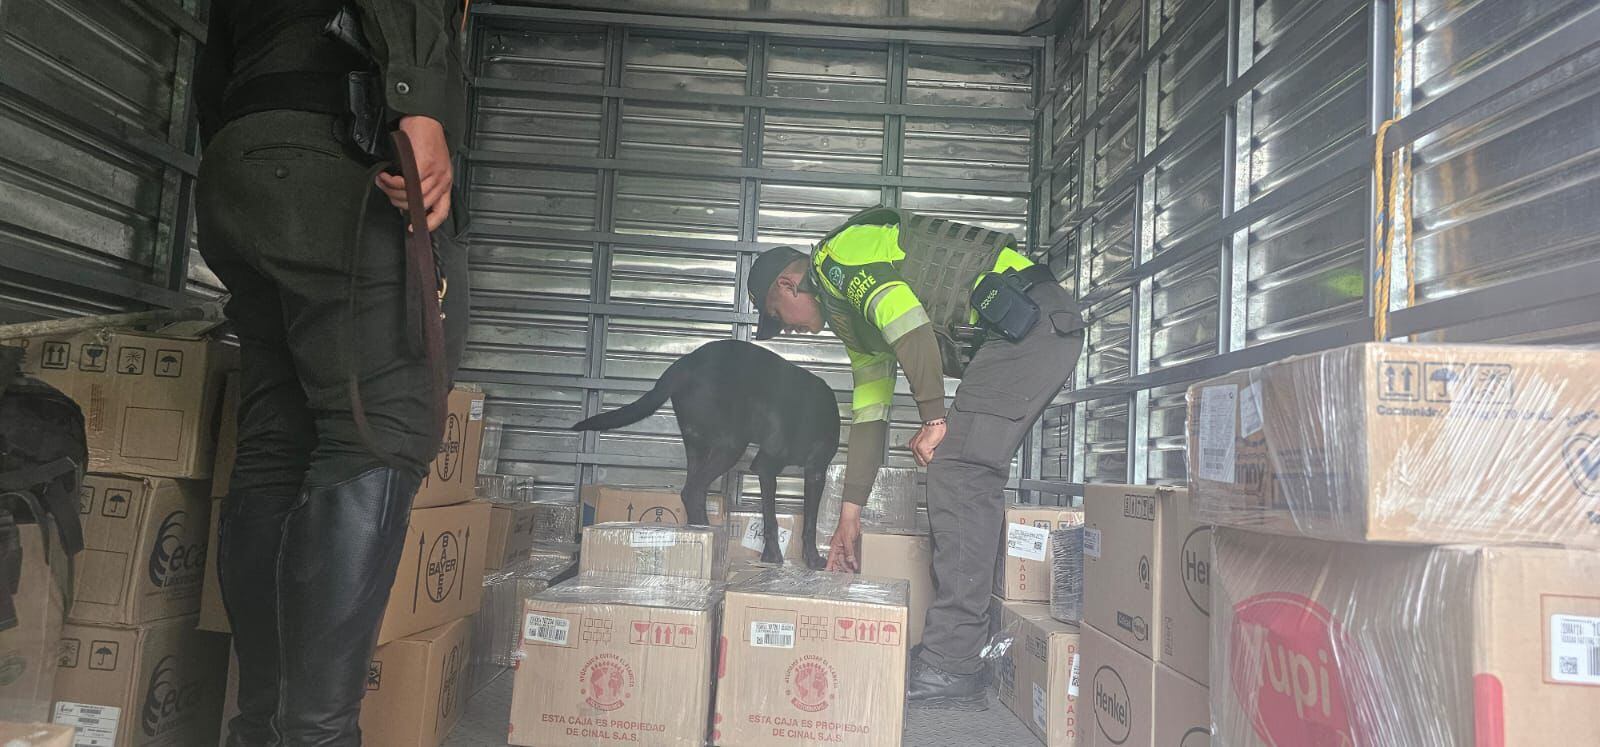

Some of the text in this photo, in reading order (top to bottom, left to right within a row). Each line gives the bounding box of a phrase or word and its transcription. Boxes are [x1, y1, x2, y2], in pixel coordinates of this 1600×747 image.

[859, 269, 867, 278] Y
[429, 559, 456, 576] BAYER
[437, 535, 449, 600] BAYER
[1096, 680, 1128, 727] Henkel
[542, 713, 666, 733] ESTA CAJA ES PROPIEDAD
[748, 714, 870, 734] ESTA CAJA ES PROPIEDAD
[566, 727, 640, 742] DE CINAL S.A.S.
[772, 728, 785, 737] DE
[787, 729, 815, 740] CINAL
